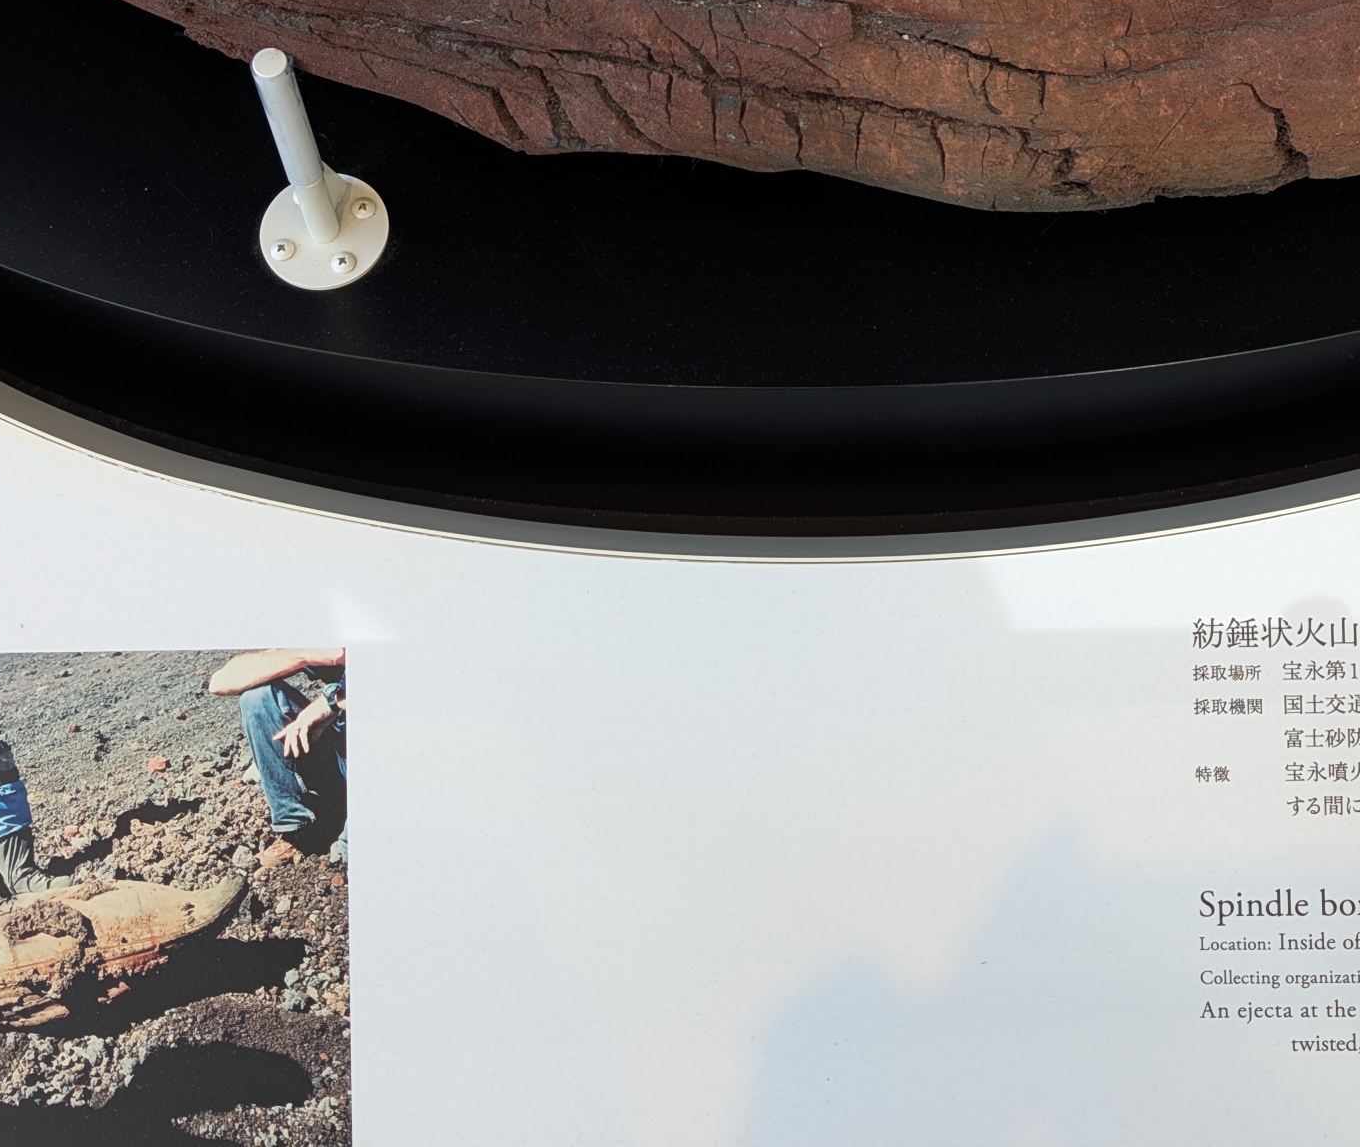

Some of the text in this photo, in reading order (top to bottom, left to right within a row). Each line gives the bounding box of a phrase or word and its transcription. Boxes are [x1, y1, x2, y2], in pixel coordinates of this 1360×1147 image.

[1193, 665, 1261, 681] 採取場所
[1193, 698, 1262, 715] 採取機関
[1195, 766, 1230, 783] 特徴
[1199, 888, 1308, 926] Spindle
[1199, 937, 1271, 950] Location:
[1279, 932, 1336, 950] Inside
[1200, 970, 1280, 989] Collecting
